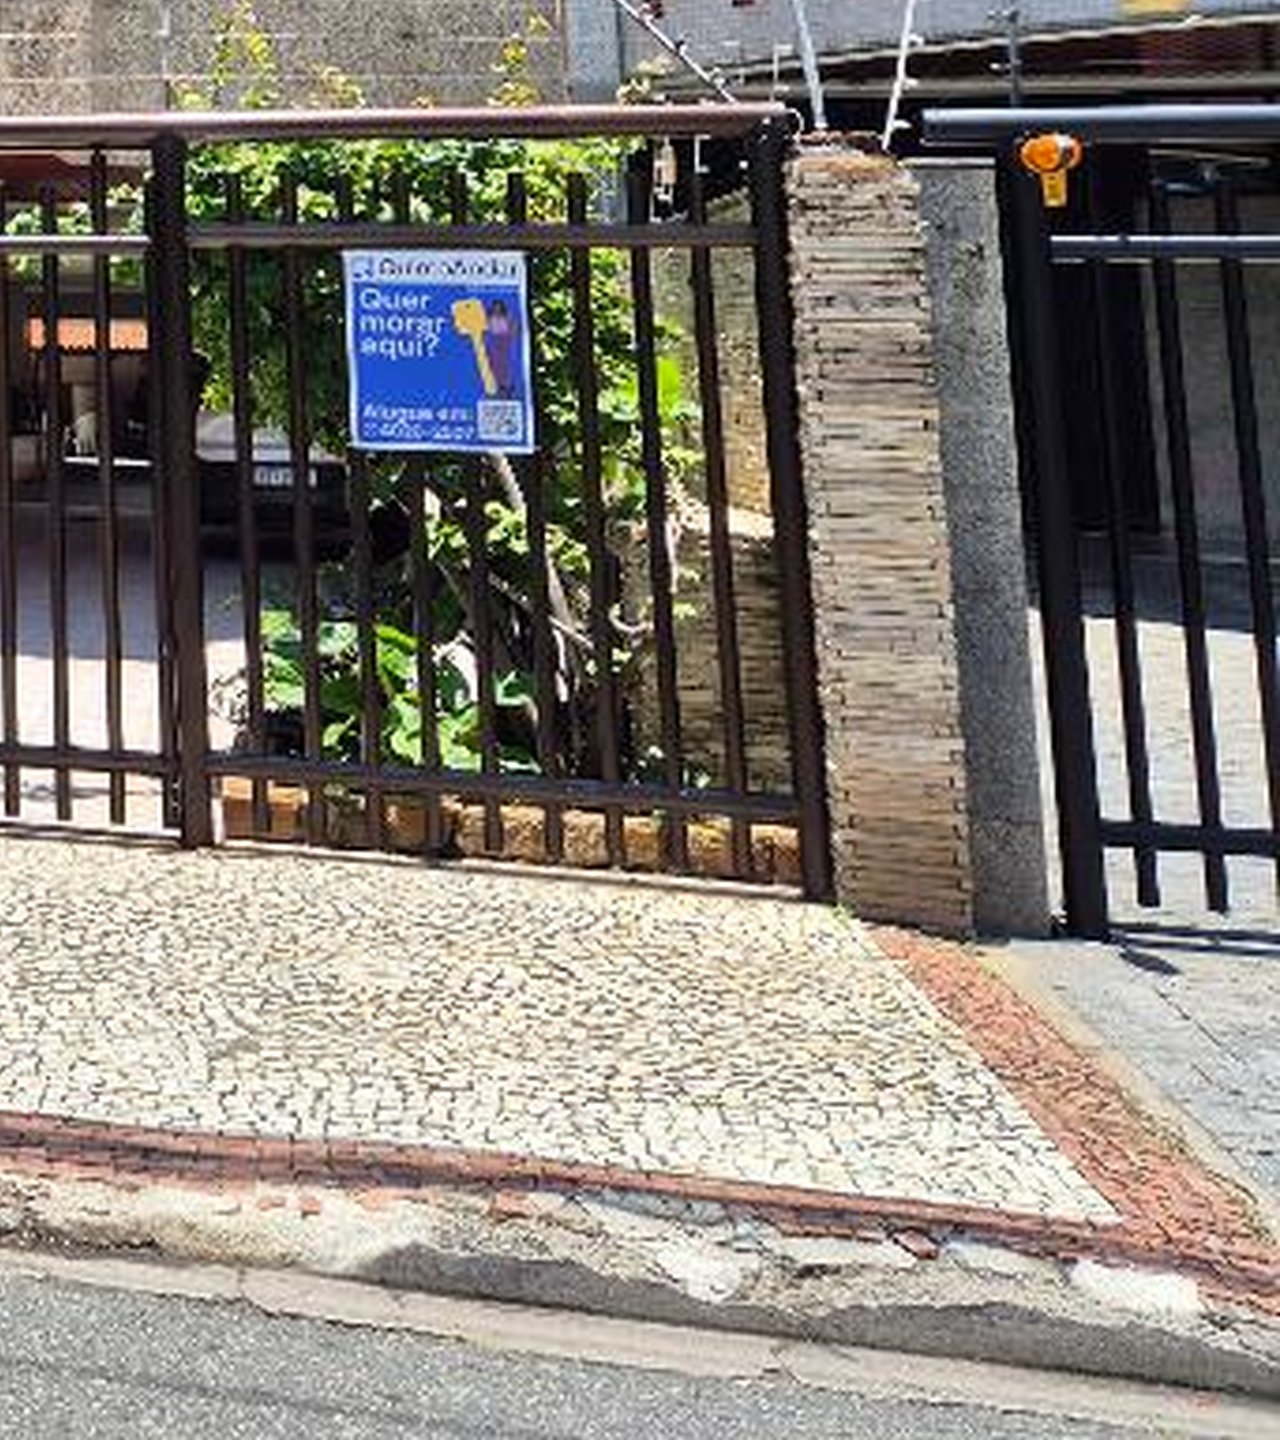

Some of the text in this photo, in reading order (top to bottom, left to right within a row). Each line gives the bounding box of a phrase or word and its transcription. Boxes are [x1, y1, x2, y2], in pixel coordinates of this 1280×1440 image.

[359, 287, 432, 310] Quer
[359, 313, 445, 333] morar
[359, 333, 440, 360] aqui?
